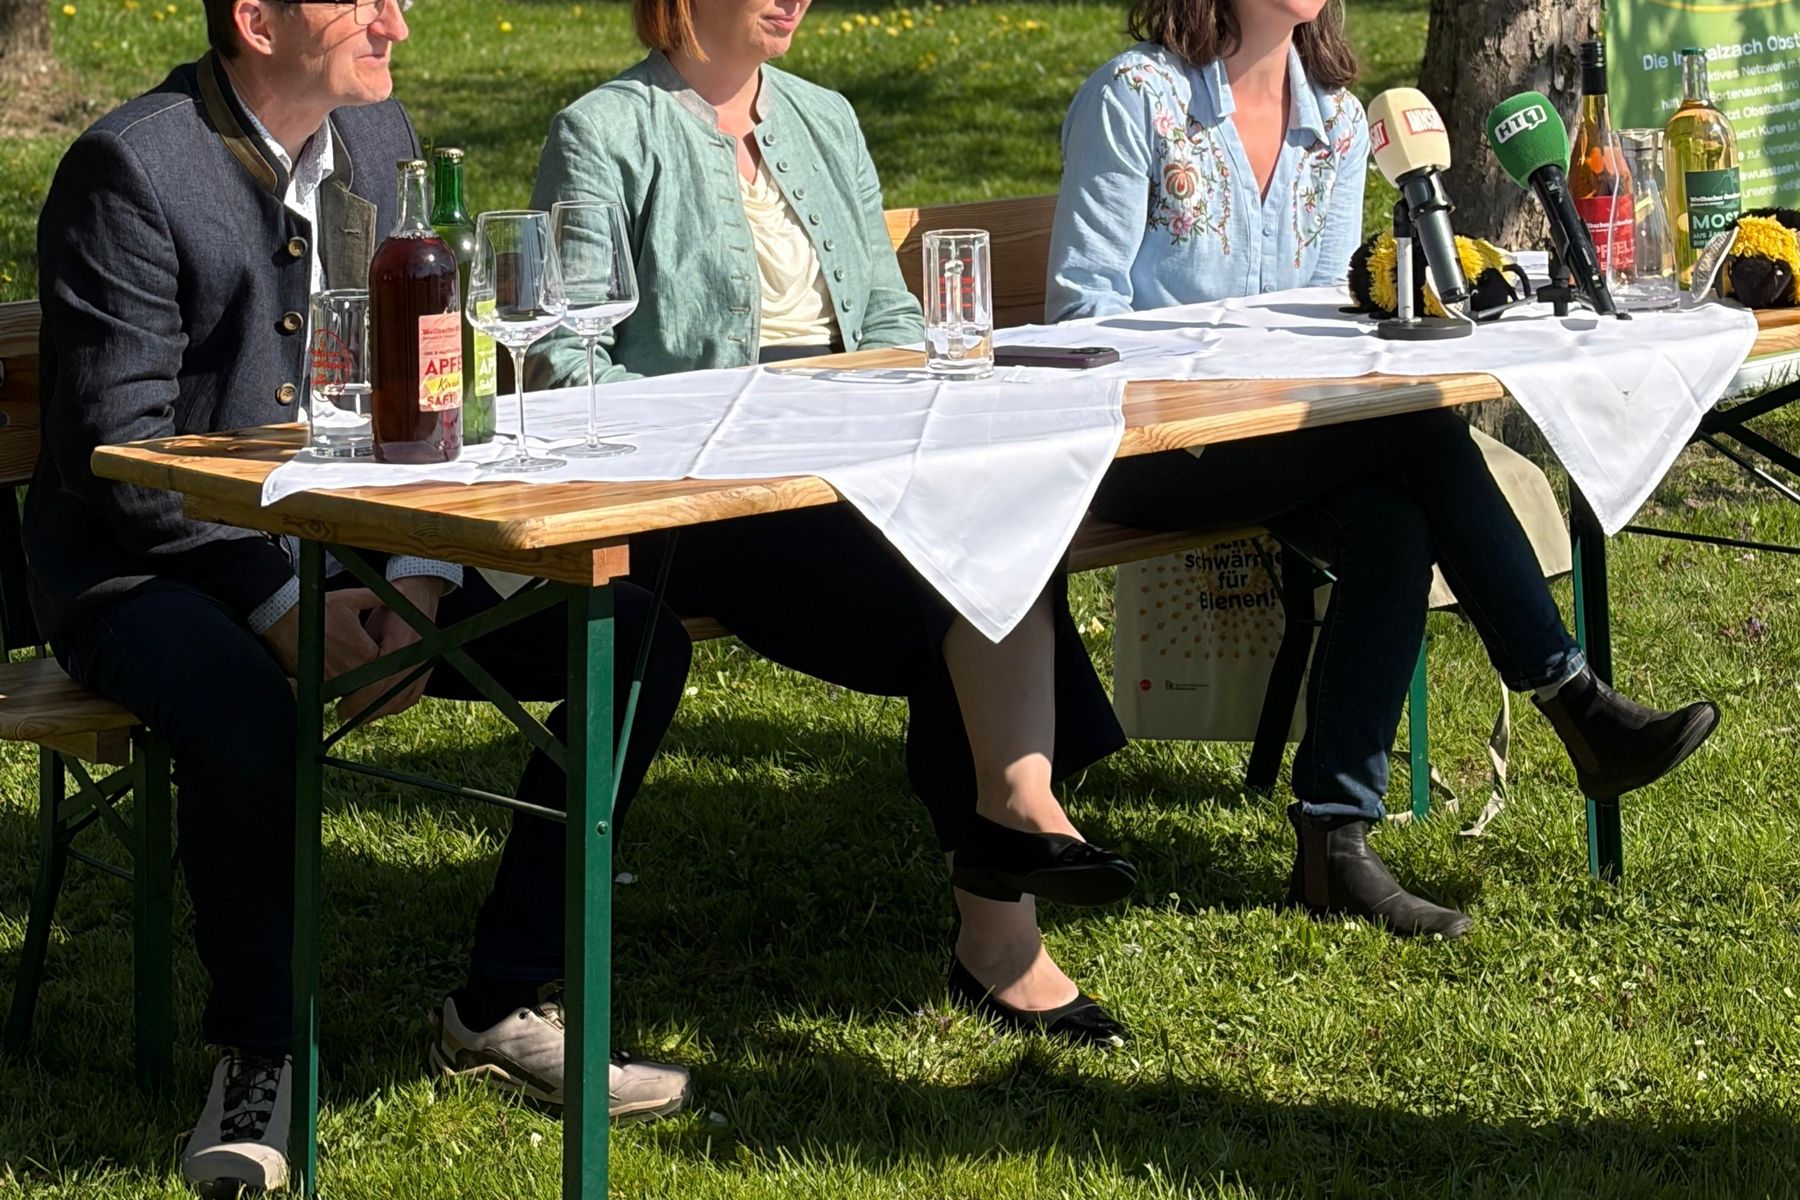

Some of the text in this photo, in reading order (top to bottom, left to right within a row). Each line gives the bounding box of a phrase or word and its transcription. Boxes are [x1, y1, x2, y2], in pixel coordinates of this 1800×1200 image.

[1643, 55, 1668, 70] Die
[1741, 61, 1786, 76] Netzwerk
[1709, 80, 1783, 103] Sortenauswahl
[1497, 106, 1545, 141] HT1
[427, 394, 454, 407] SAFT
[1218, 570, 1248, 590] für
[1200, 587, 1276, 611] Bienen!
